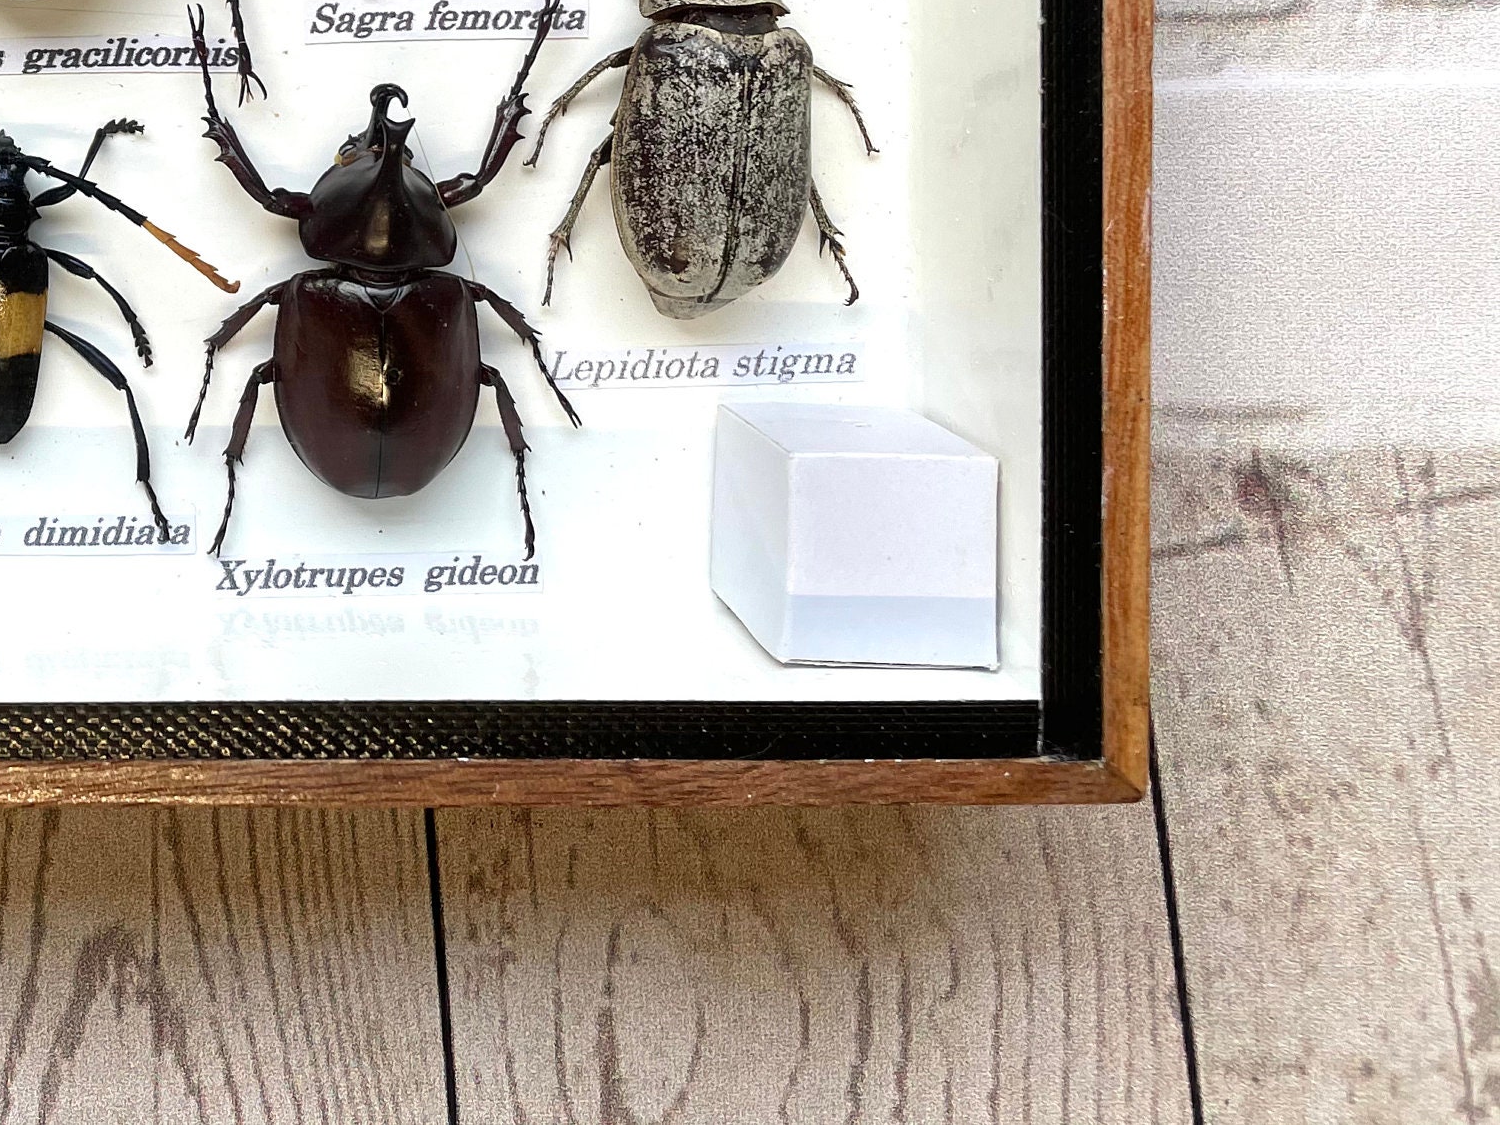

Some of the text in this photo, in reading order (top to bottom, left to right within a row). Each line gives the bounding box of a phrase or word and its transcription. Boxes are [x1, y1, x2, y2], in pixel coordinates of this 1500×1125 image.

[310, 2, 414, 38] Sagra
[551, 345, 857, 387] Lepidiota stigma
[215, 555, 540, 596] Xylotrupes gideon
